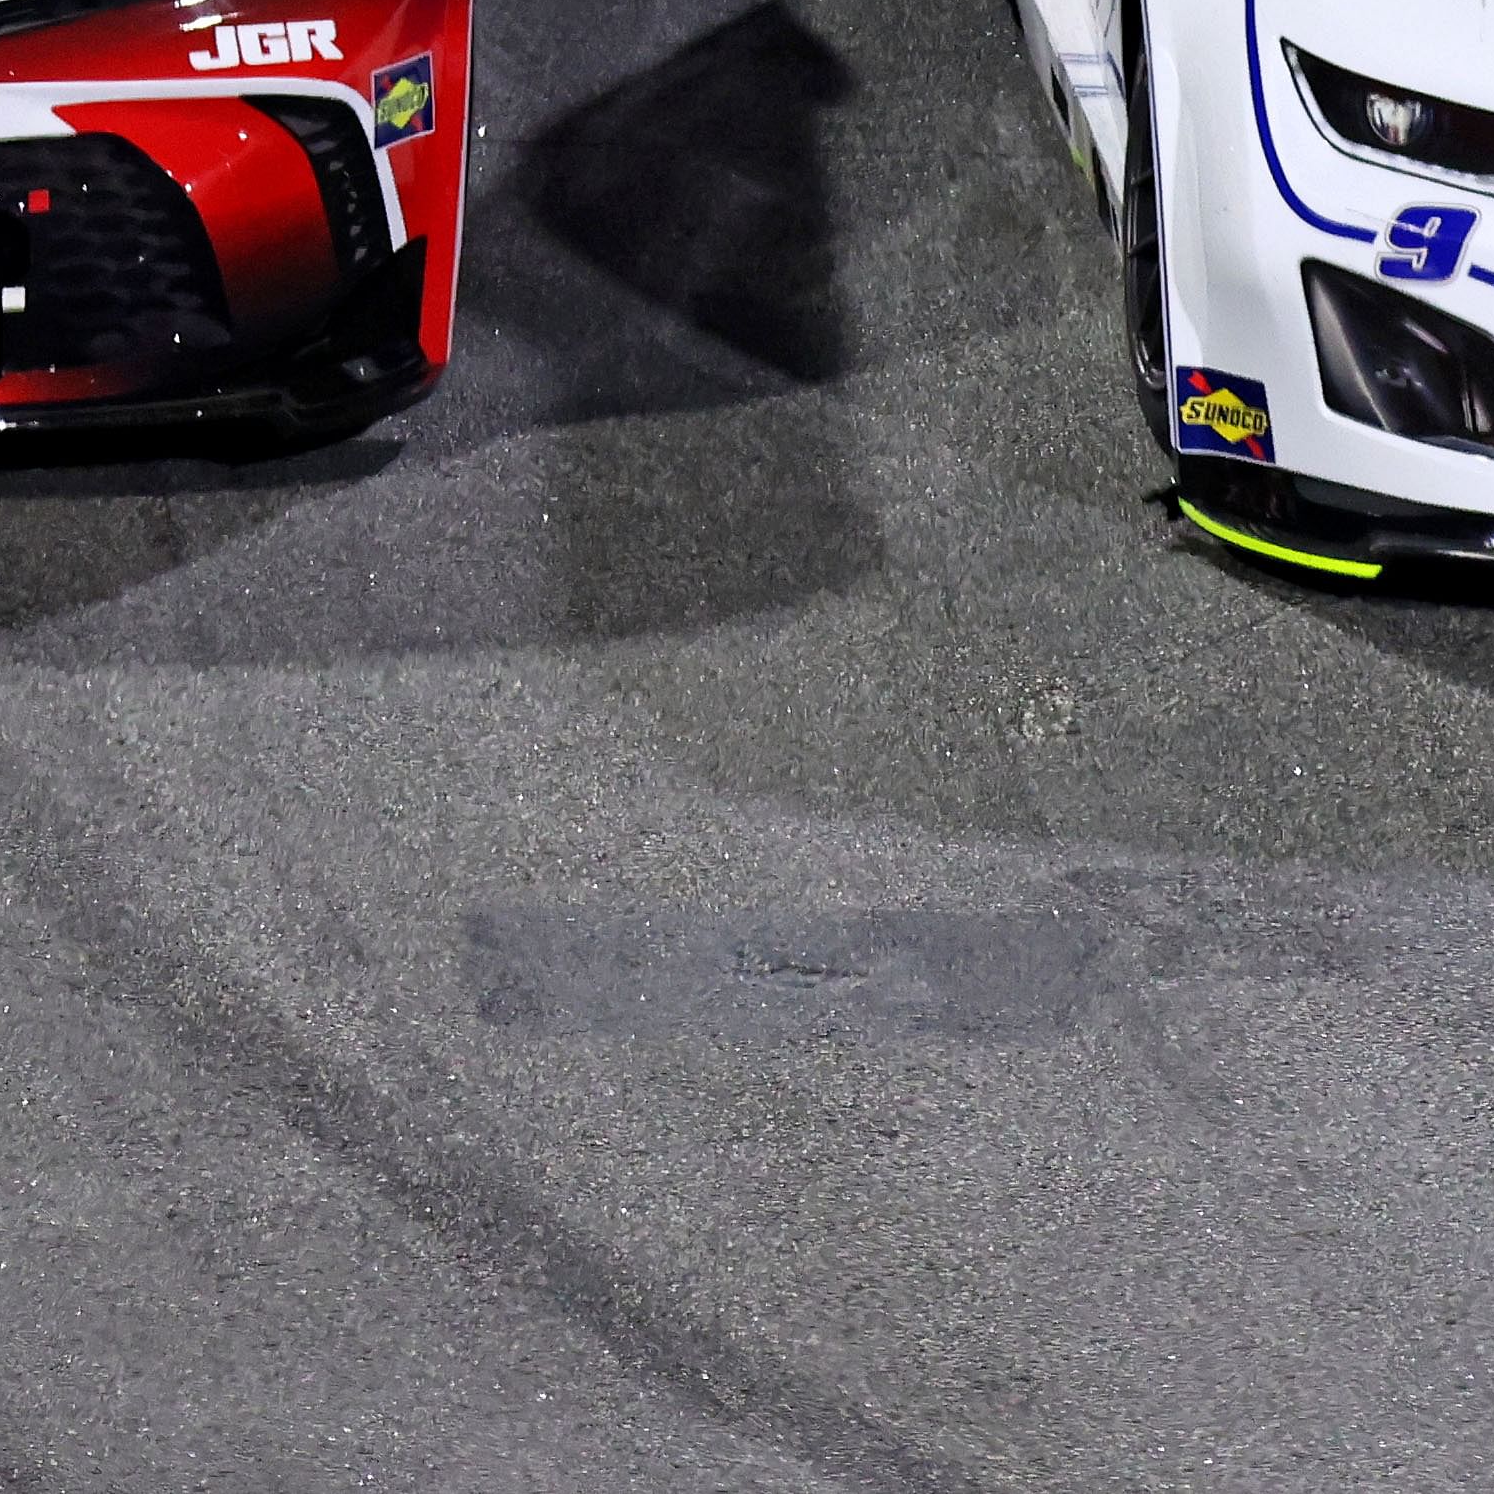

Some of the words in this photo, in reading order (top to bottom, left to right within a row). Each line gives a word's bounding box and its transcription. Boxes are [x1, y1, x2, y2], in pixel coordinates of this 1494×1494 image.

[189, 19, 344, 72] JGR
[1374, 202, 1481, 284] 9
[1186, 399, 1265, 433] SUNOCO
